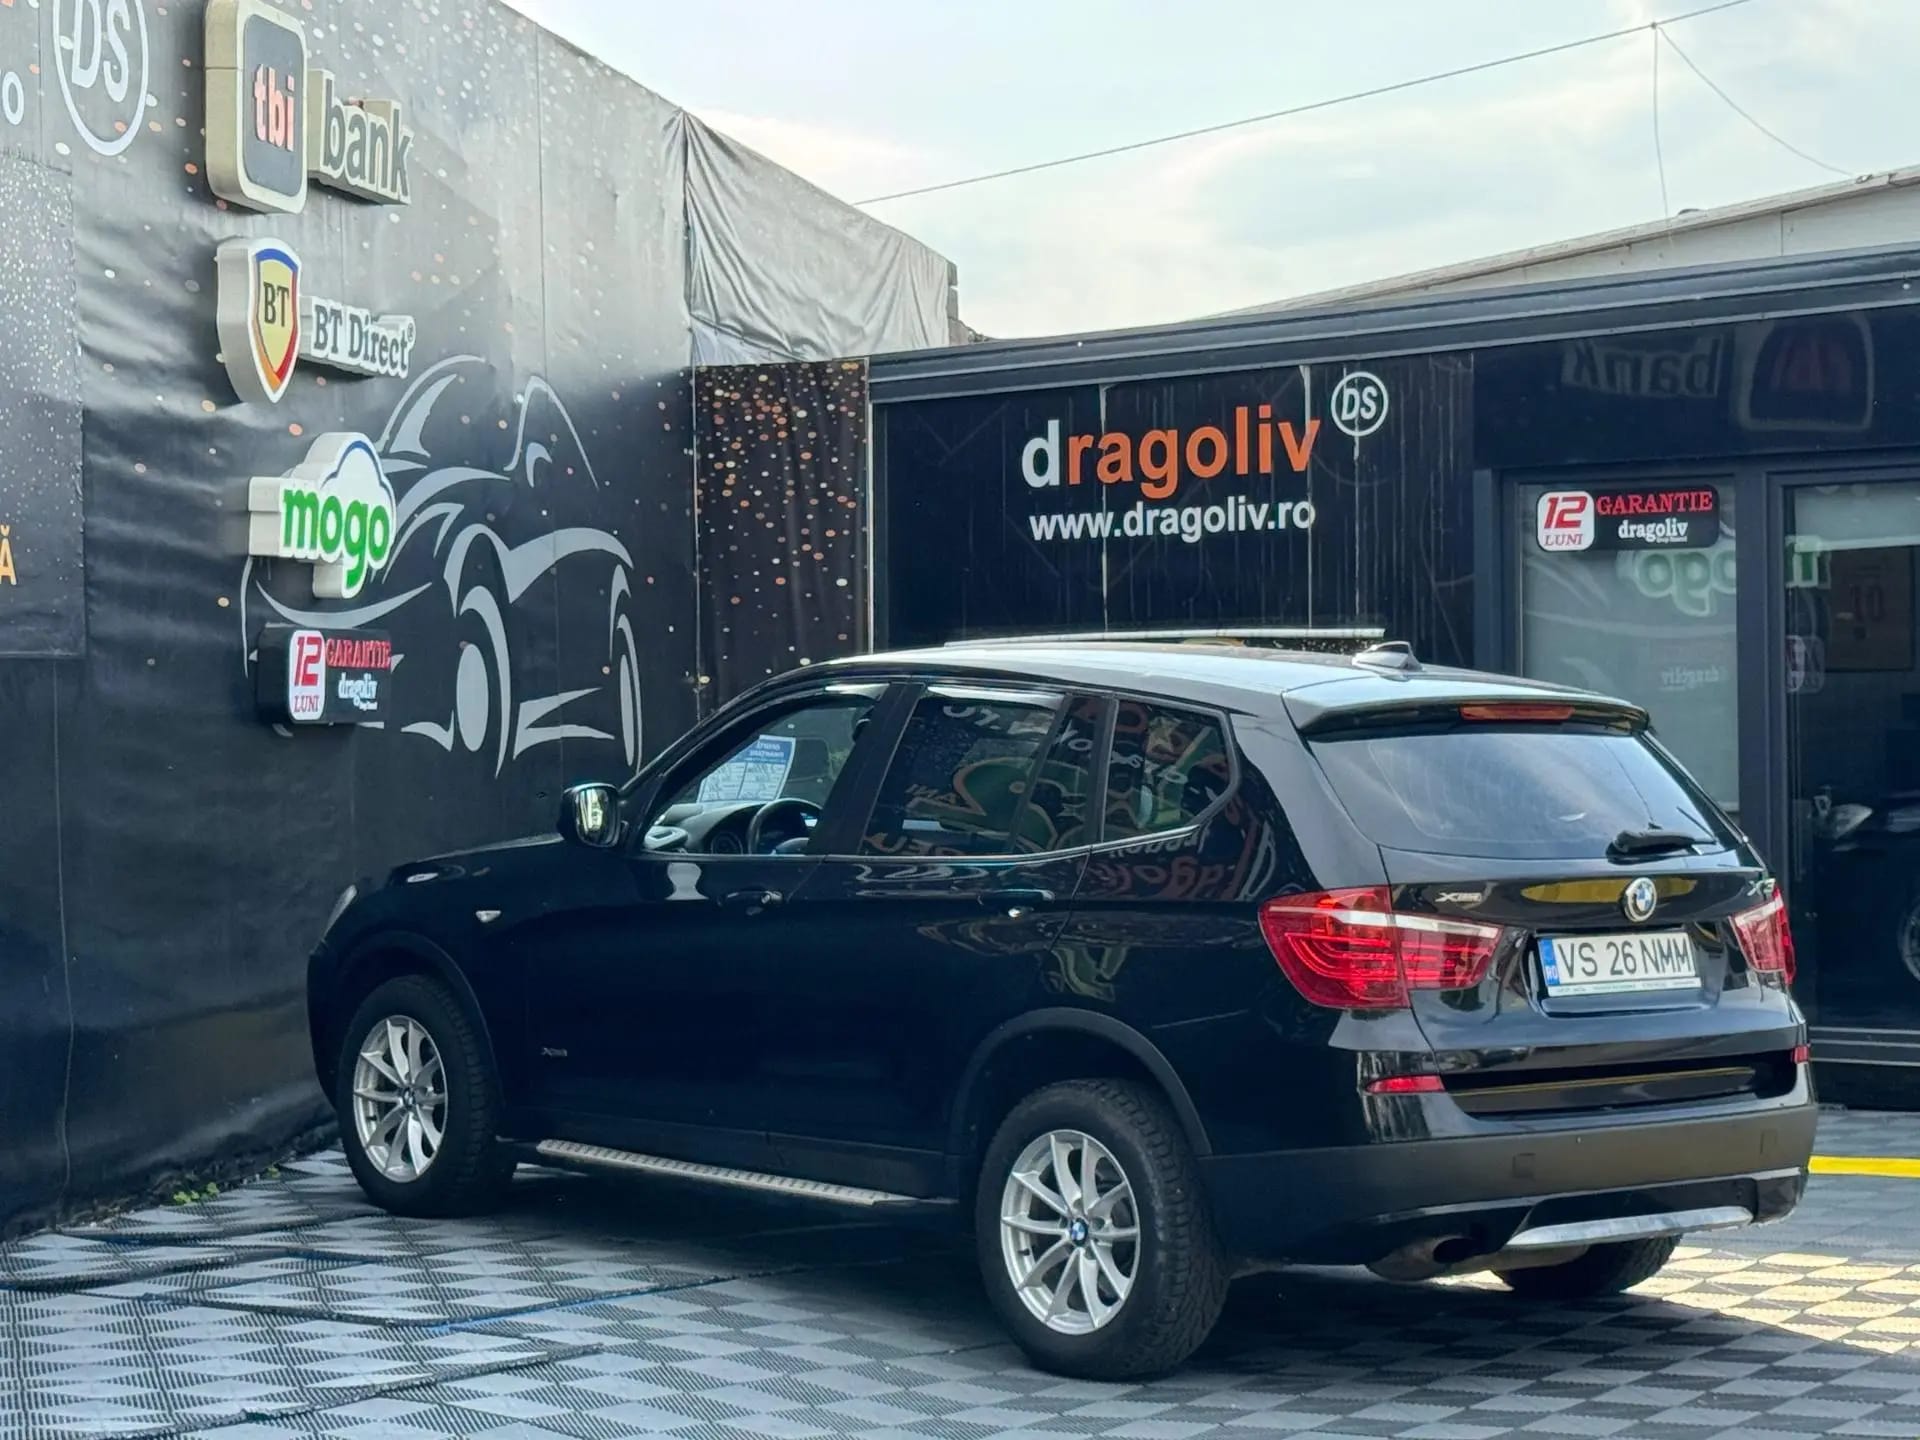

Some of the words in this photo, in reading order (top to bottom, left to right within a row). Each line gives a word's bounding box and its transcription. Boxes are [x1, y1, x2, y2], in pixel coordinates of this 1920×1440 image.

[254, 63, 294, 152] tbi
[324, 78, 411, 197] bank
[263, 282, 290, 327] BT
[314, 305, 342, 360] BT
[1340, 385, 1378, 422] DS
[1021, 404, 1320, 499] dragoliv
[1029, 495, 1316, 543] www.dragoliv.ro
[1544, 495, 1588, 529] 12
[1596, 491, 1713, 516] GARANTIE
[283, 489, 390, 589] mogo
[1545, 533, 1583, 547] LUNI
[1618, 518, 1688, 543] dragoliv
[294, 636, 323, 687] 12
[294, 695, 320, 713] LUNI
[1558, 942, 1598, 978] VS
[1606, 940, 1637, 975] 26
[1640, 937, 1692, 974] NMM
